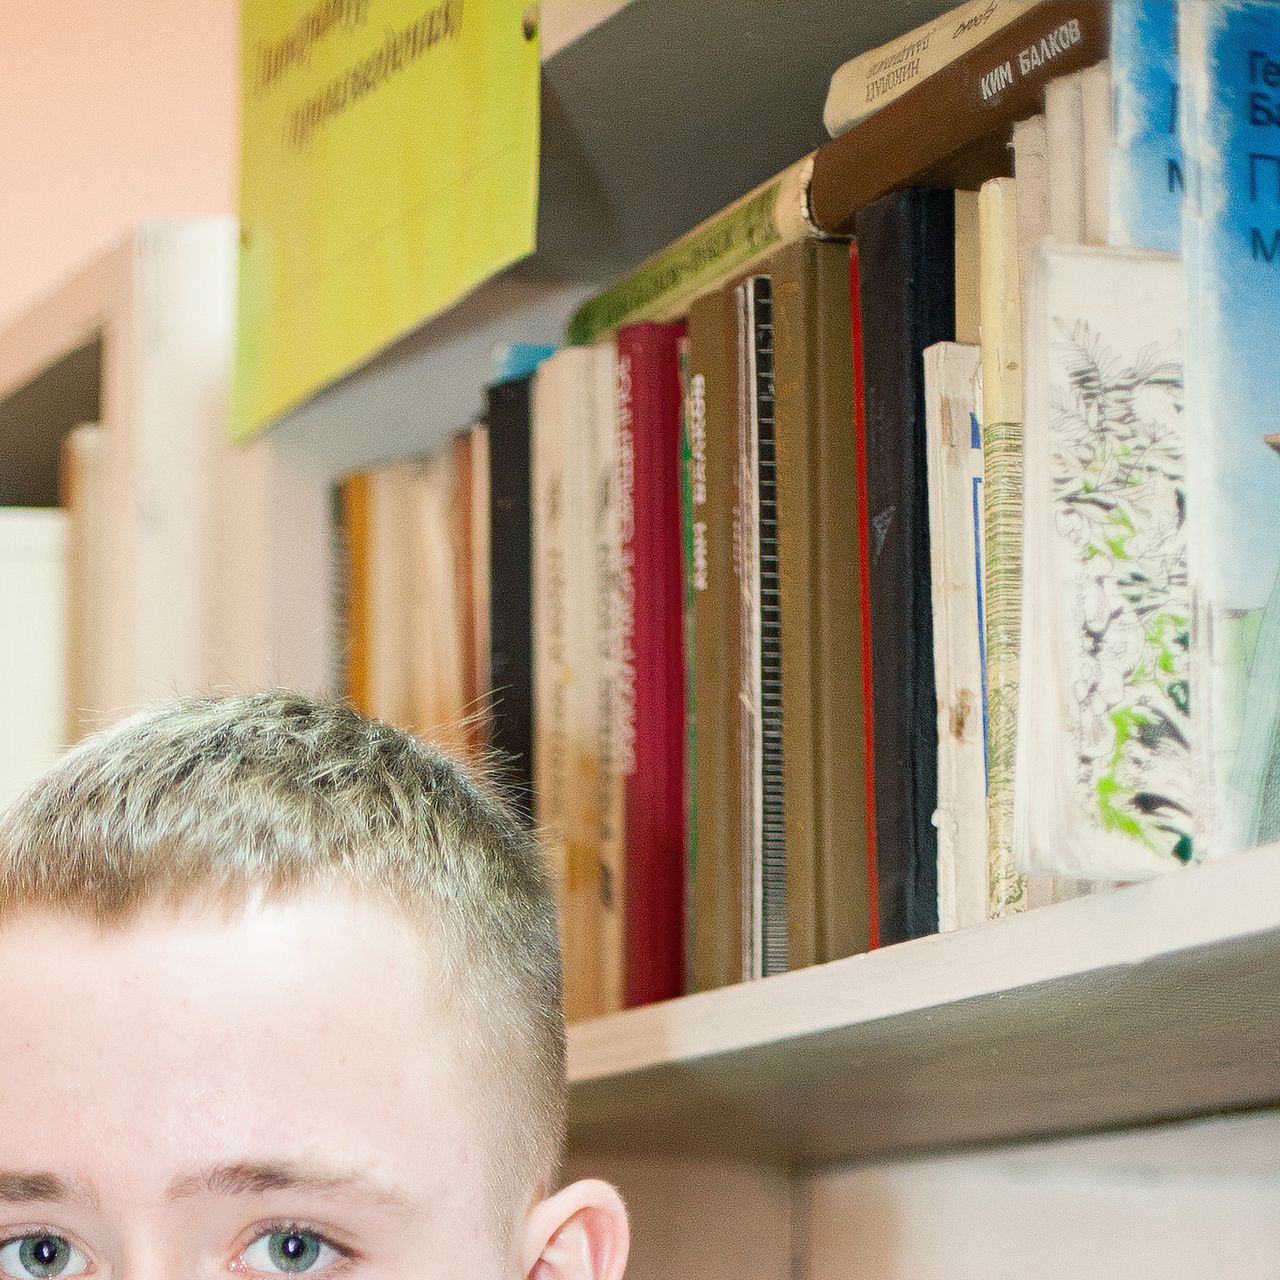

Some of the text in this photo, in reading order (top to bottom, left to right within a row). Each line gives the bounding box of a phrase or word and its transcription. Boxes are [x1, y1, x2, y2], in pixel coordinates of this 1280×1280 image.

[980, 61, 1014, 100] КИМ
[1019, 18, 1082, 76] БАЛКОВ
[1249, 91, 1280, 127] Б
